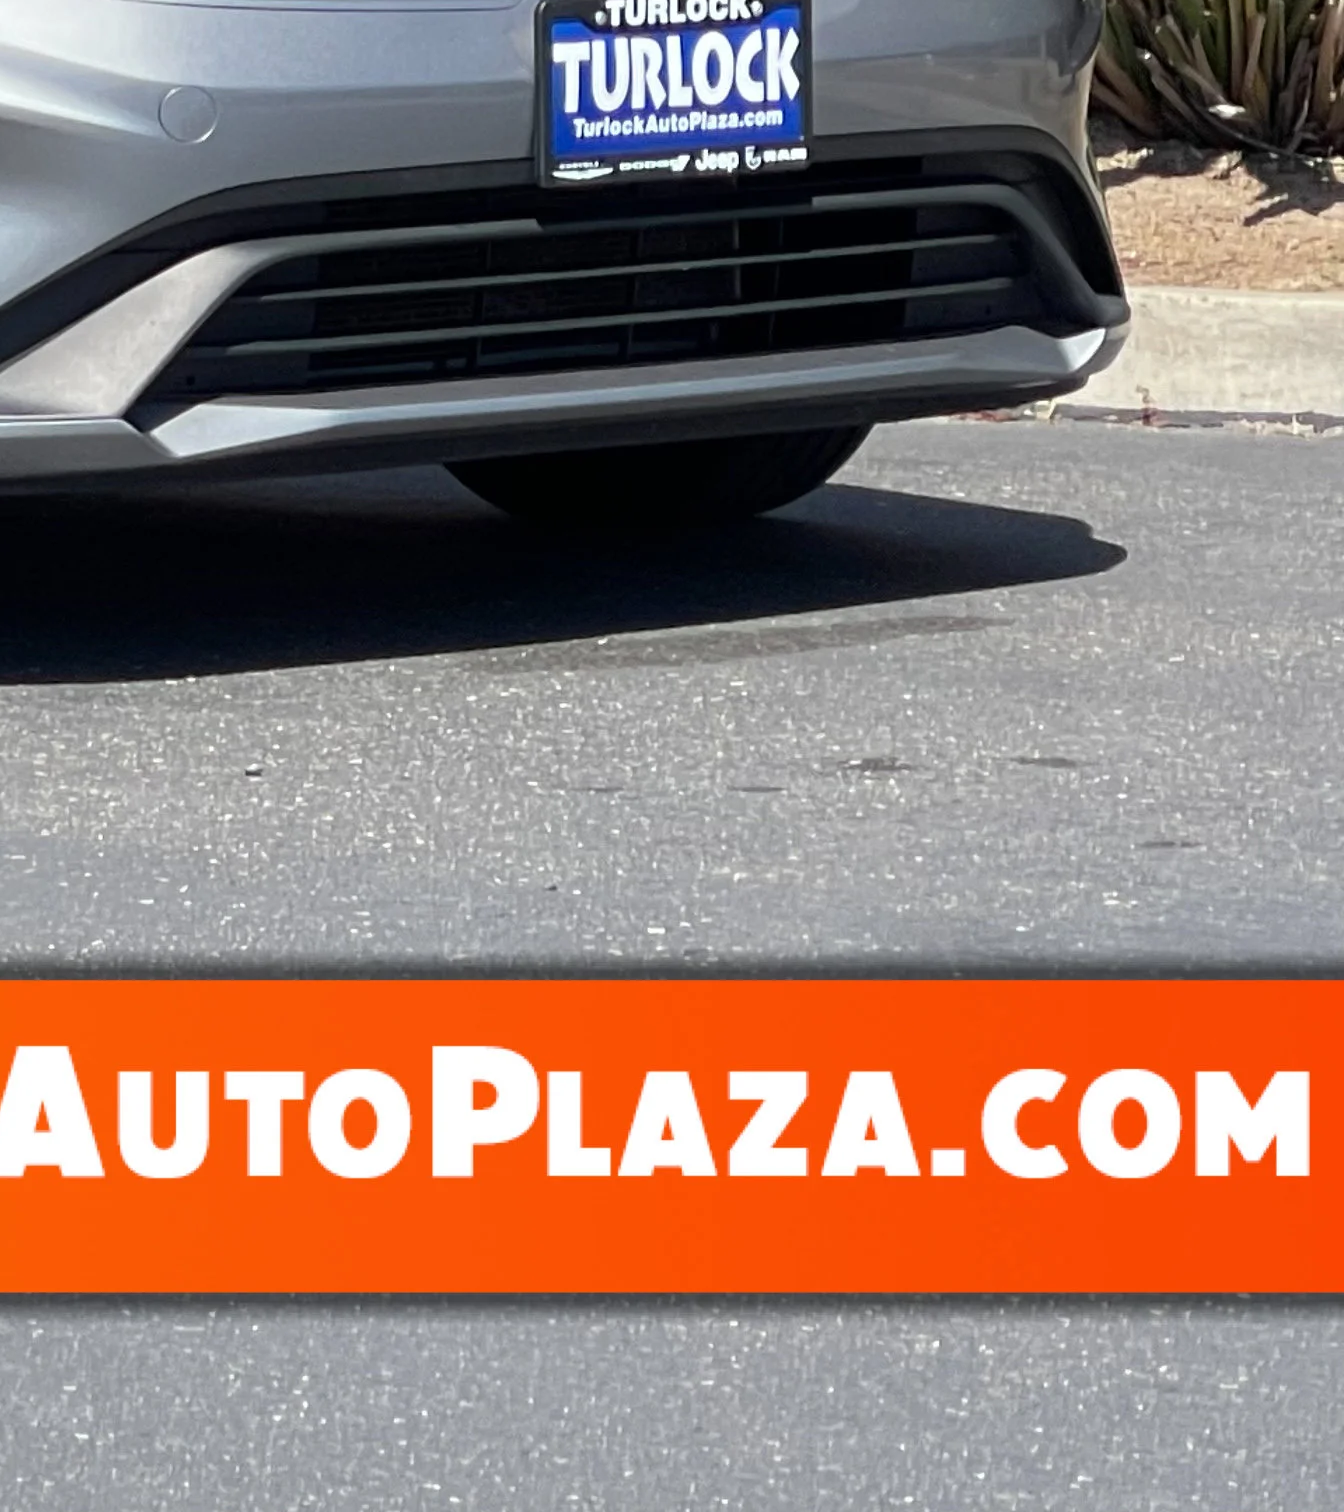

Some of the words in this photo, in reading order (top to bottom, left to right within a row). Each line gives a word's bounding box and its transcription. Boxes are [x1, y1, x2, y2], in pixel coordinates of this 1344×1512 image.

[552, 26, 801, 114] TURLOCK
[573, 109, 784, 139] TurlockAutoPlaza.com
[695, 148, 739, 173] Jeep
[763, 147, 807, 163] RAM
